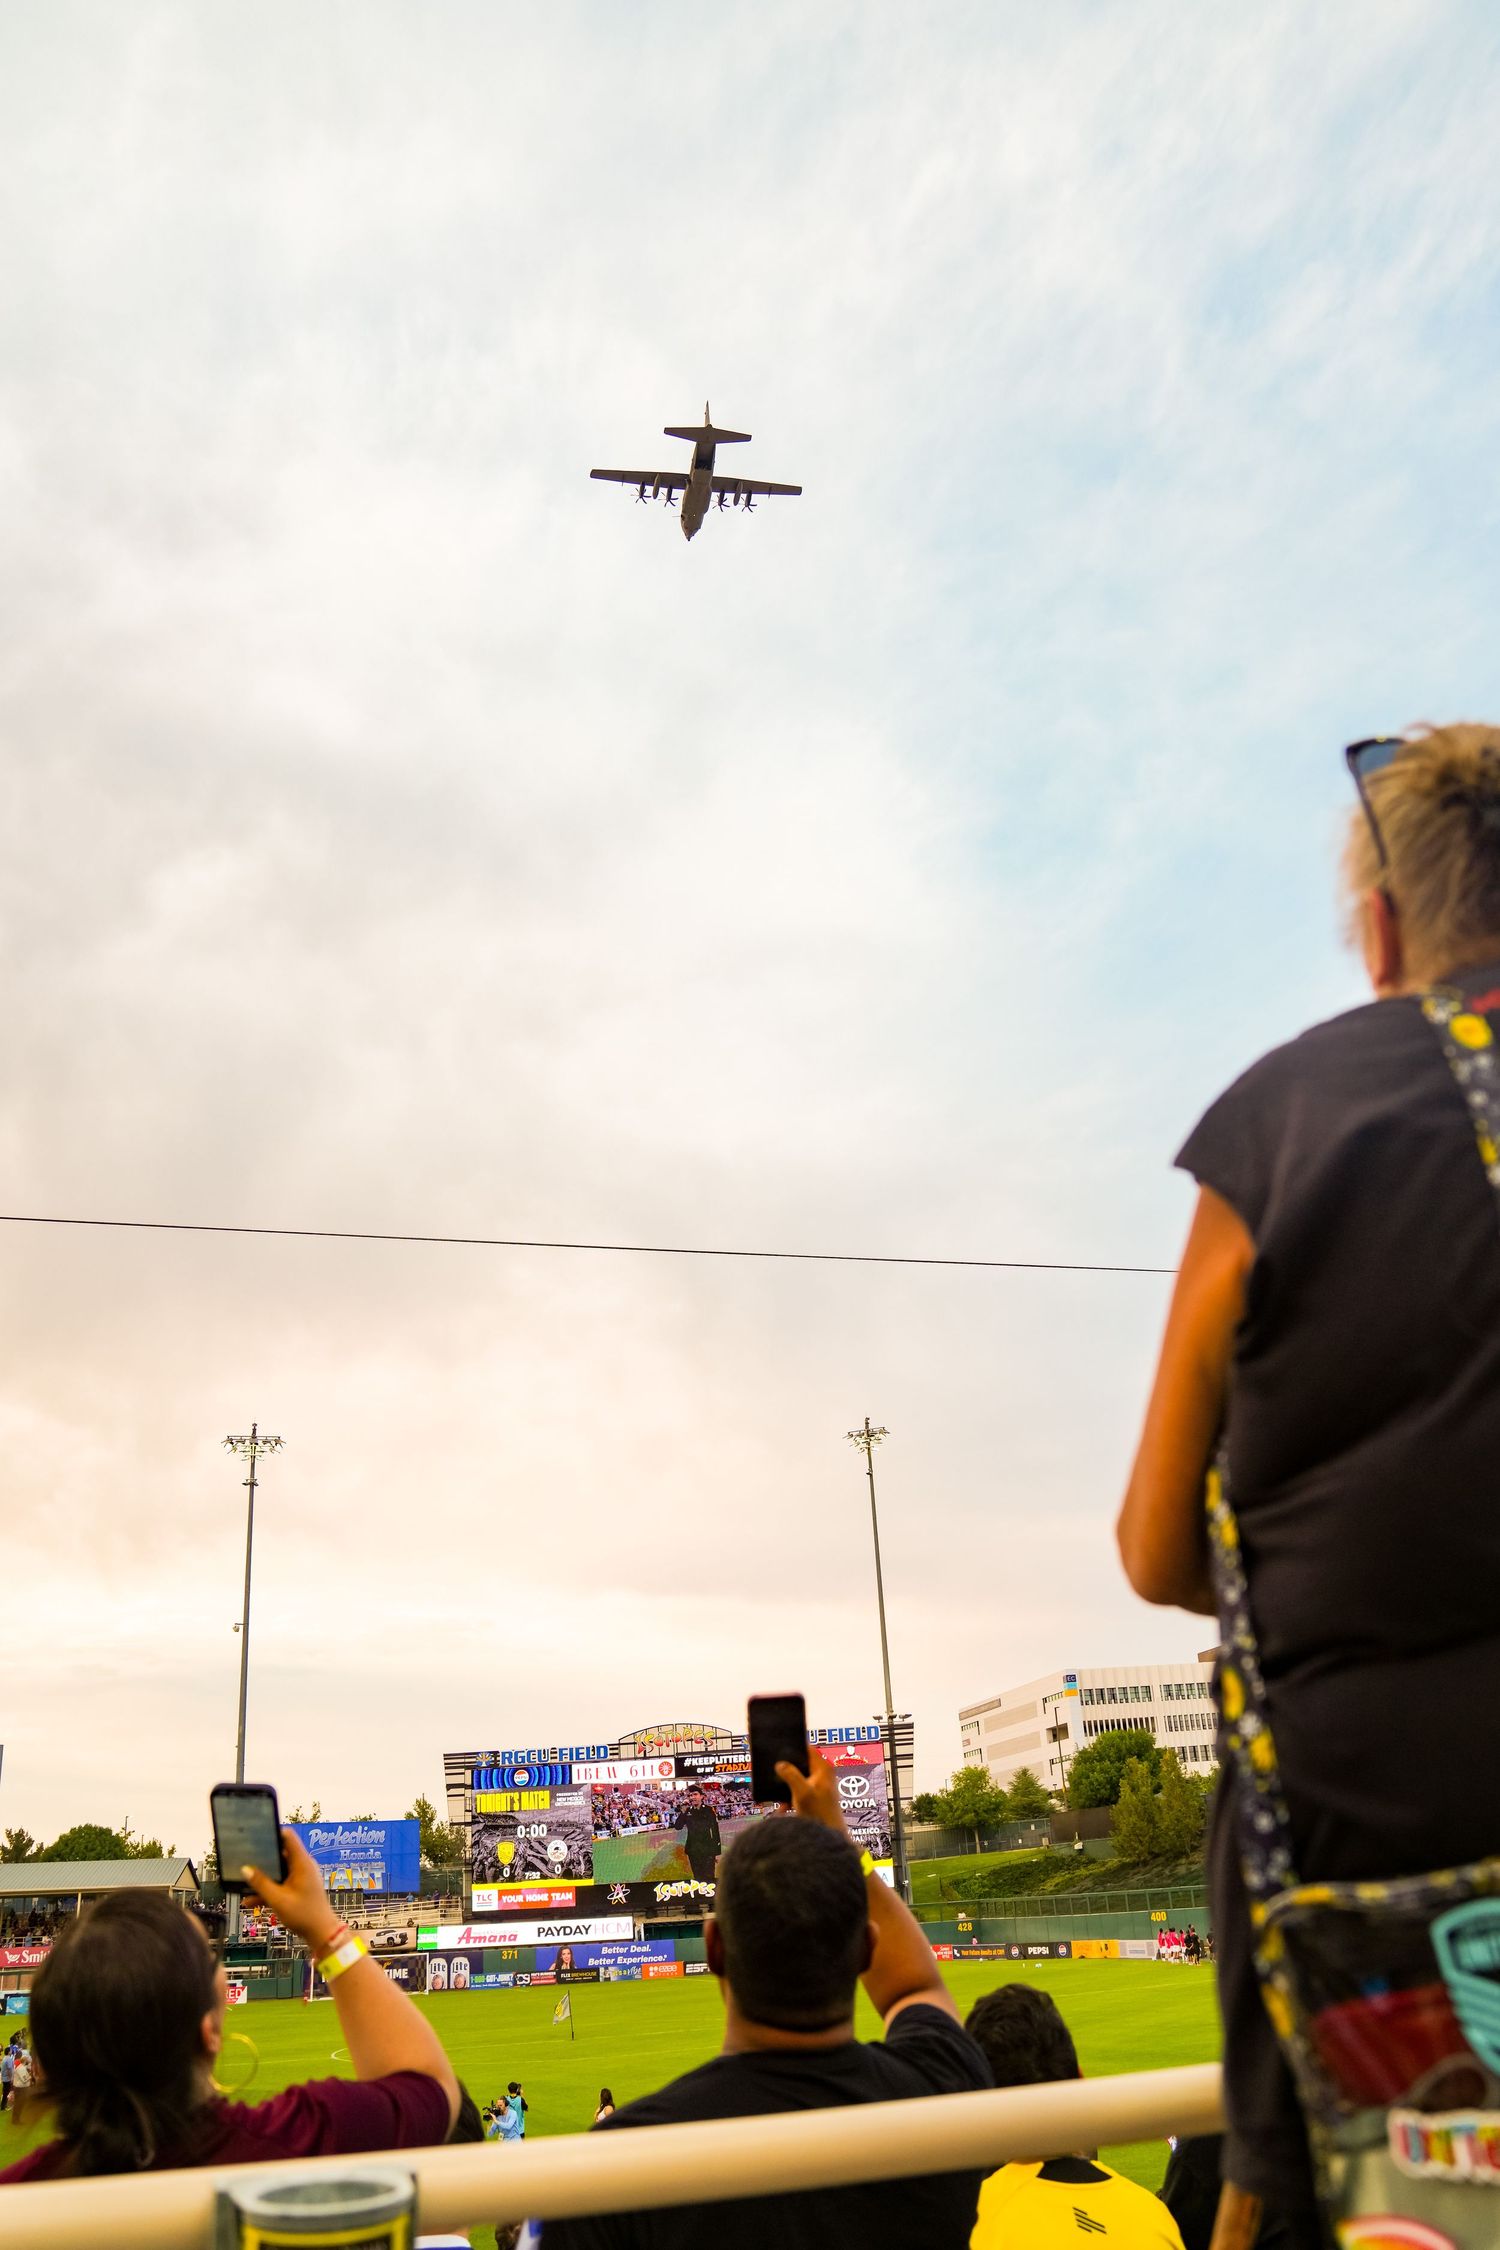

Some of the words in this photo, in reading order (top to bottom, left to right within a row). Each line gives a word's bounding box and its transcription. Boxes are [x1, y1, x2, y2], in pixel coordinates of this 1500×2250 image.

[827, 1725, 881, 1744] FIELD
[500, 1748, 550, 1765] RGCU
[558, 1745, 609, 1762] FIELD
[683, 1754, 751, 1767] #KEEPLITTERO
[630, 1764, 654, 1778] 611
[715, 1763, 751, 1773] STADIU
[476, 1792, 520, 1813] TONIGHT'S
[521, 1790, 550, 1811] MATCH
[839, 1799, 876, 1809] OYOTA
[517, 1824, 547, 1838] 0:00
[852, 1827, 880, 1835] MEXICO
[309, 1825, 386, 1849] Perfection
[340, 1849, 381, 1860] Honda
[503, 1867, 510, 1877] 0
[555, 1864, 561, 1874] 0
[320, 1867, 386, 1890] IANT
[476, 1893, 492, 1901] TLC
[502, 1894, 524, 1903] YOUR
[526, 1892, 549, 1902] HOME
[551, 1892, 573, 1901] TEAM
[1151, 1911, 1167, 1921] 400
[537, 1924, 592, 1937] PAYDAY
[594, 1922, 631, 1934] HCM
[957, 1922, 972, 1931] 428
[457, 1927, 518, 1945] Amana
[601, 1945, 628, 1954] Better
[630, 1944, 651, 1953] Deal.
[1027, 1946, 1049, 1955] PEPSI
[21, 1949, 50, 1964] Smit
[502, 1950, 518, 1960] 371
[452, 1961, 468, 1973] Lite
[588, 1957, 615, 1966] Better
[430, 1962, 446, 1974] Lite
